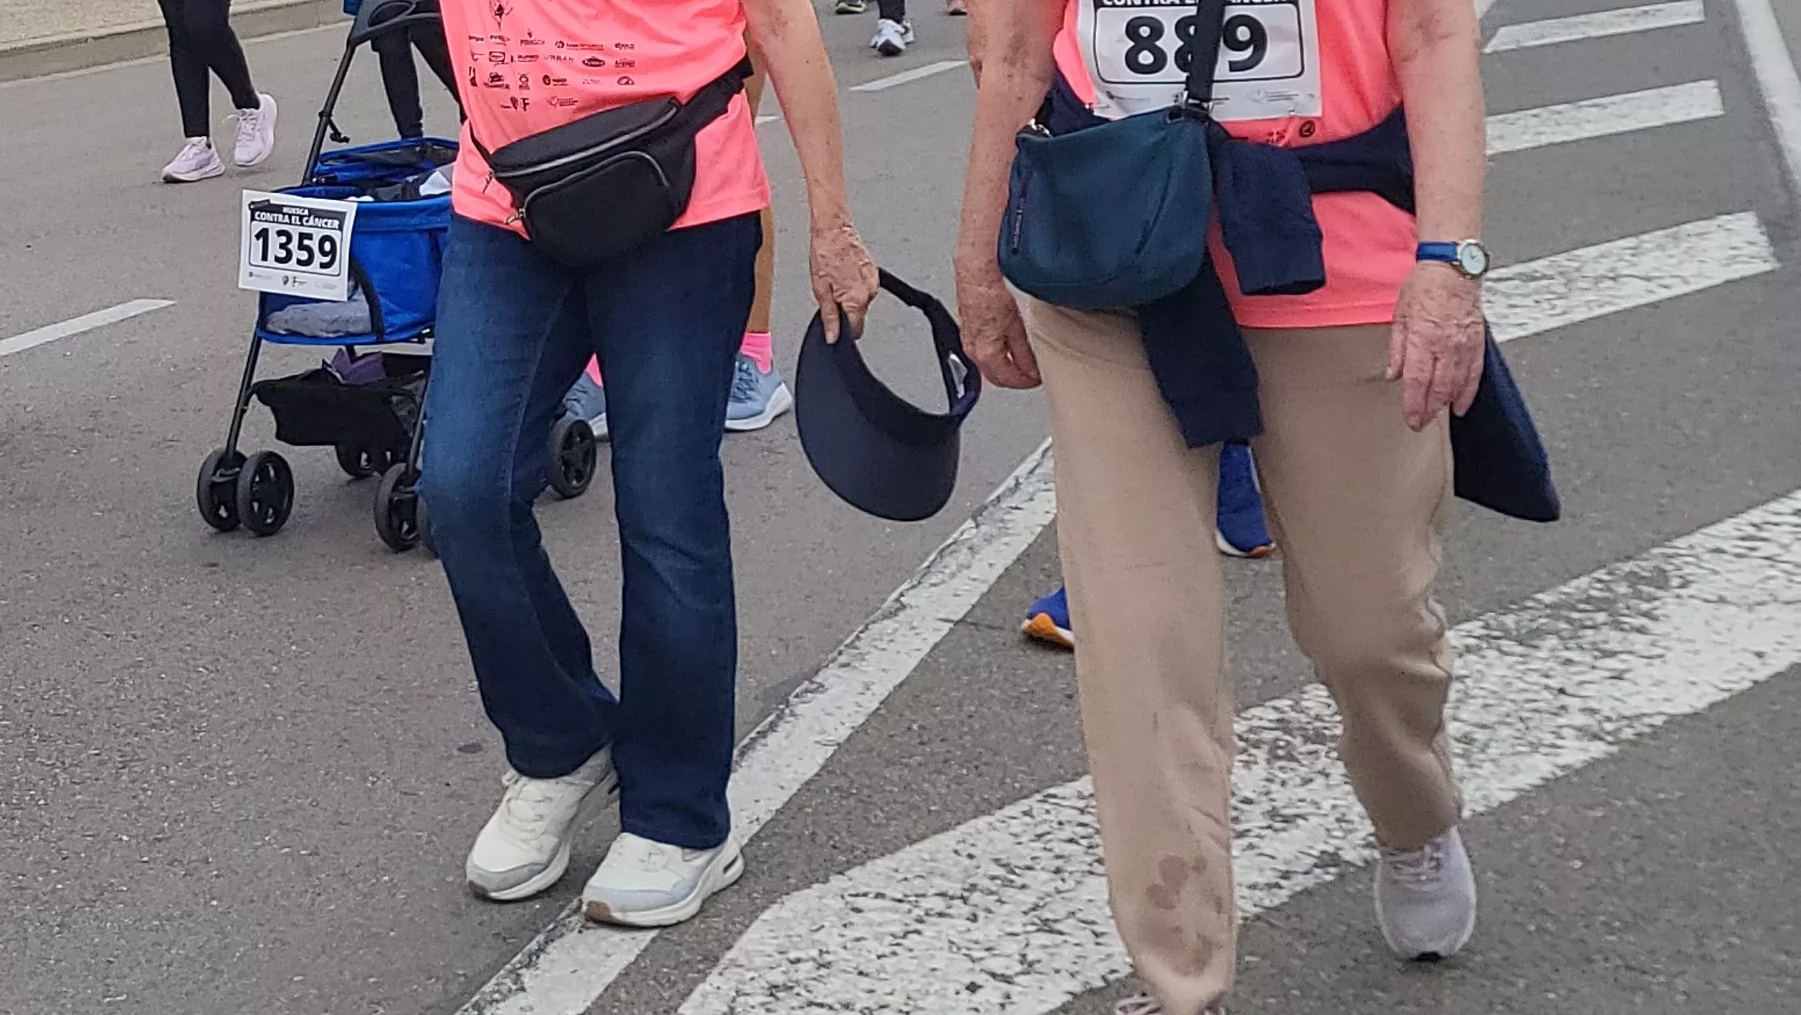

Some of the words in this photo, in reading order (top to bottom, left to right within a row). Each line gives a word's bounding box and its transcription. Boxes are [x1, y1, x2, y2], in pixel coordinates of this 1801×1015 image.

[1124, 14, 1268, 75] 889
[255, 211, 290, 224] CONTRA
[291, 216, 301, 225] EL
[302, 215, 340, 229] CÁNCER
[282, 207, 309, 215] HUESCA
[254, 228, 337, 270] 1359
